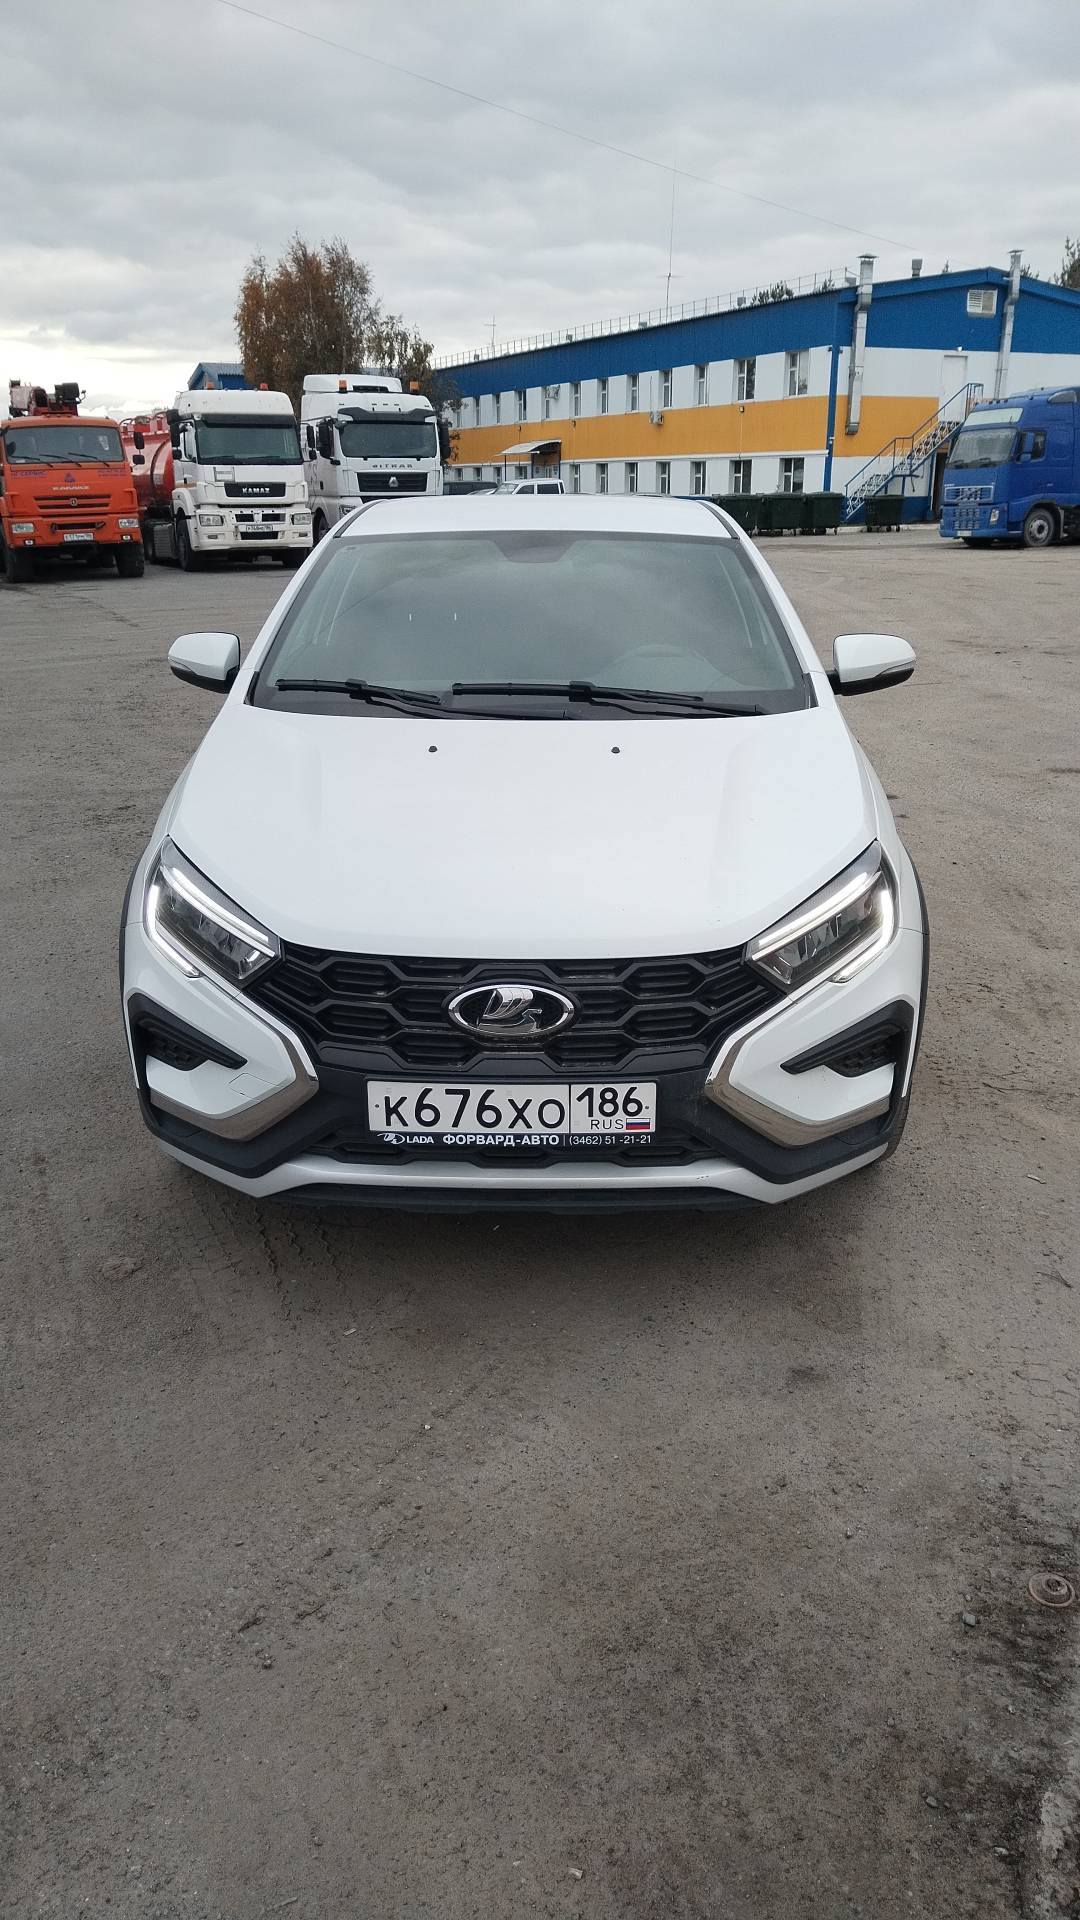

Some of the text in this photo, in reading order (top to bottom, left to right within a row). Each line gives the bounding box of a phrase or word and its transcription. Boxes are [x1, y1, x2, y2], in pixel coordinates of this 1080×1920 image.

[383, 1086, 643, 1129] К676ХО 186
[590, 1118, 625, 1131] RUS
[406, 1135, 435, 1144] LADA
[442, 1133, 560, 1147] ФОРВАРД-АВТО
[569, 1134, 603, 1145] (3462)
